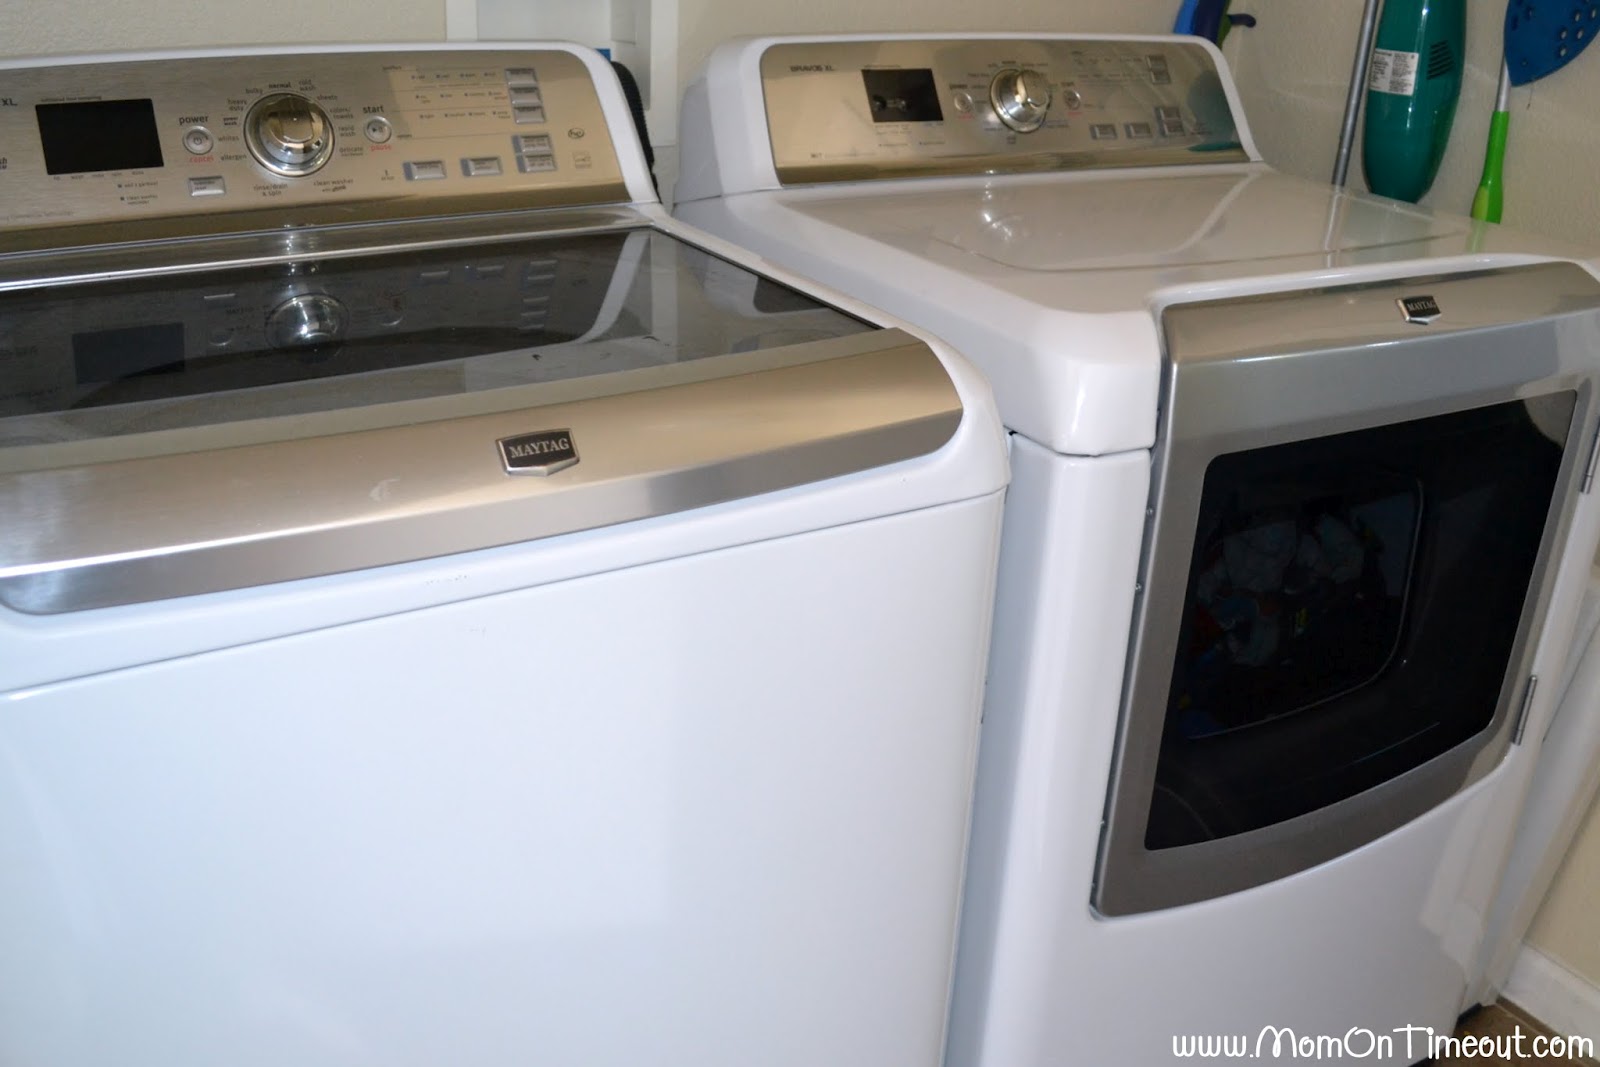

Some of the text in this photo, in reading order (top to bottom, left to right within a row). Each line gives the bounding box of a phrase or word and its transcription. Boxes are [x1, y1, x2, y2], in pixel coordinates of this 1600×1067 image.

[268, 81, 291, 89] normal
[1, 98, 18, 107] XL
[362, 105, 384, 114] start
[178, 115, 209, 126] power
[370, 144, 392, 152] pause
[189, 154, 215, 163] cancel
[220, 153, 248, 161] allergen
[509, 437, 570, 459] MAYTAG
